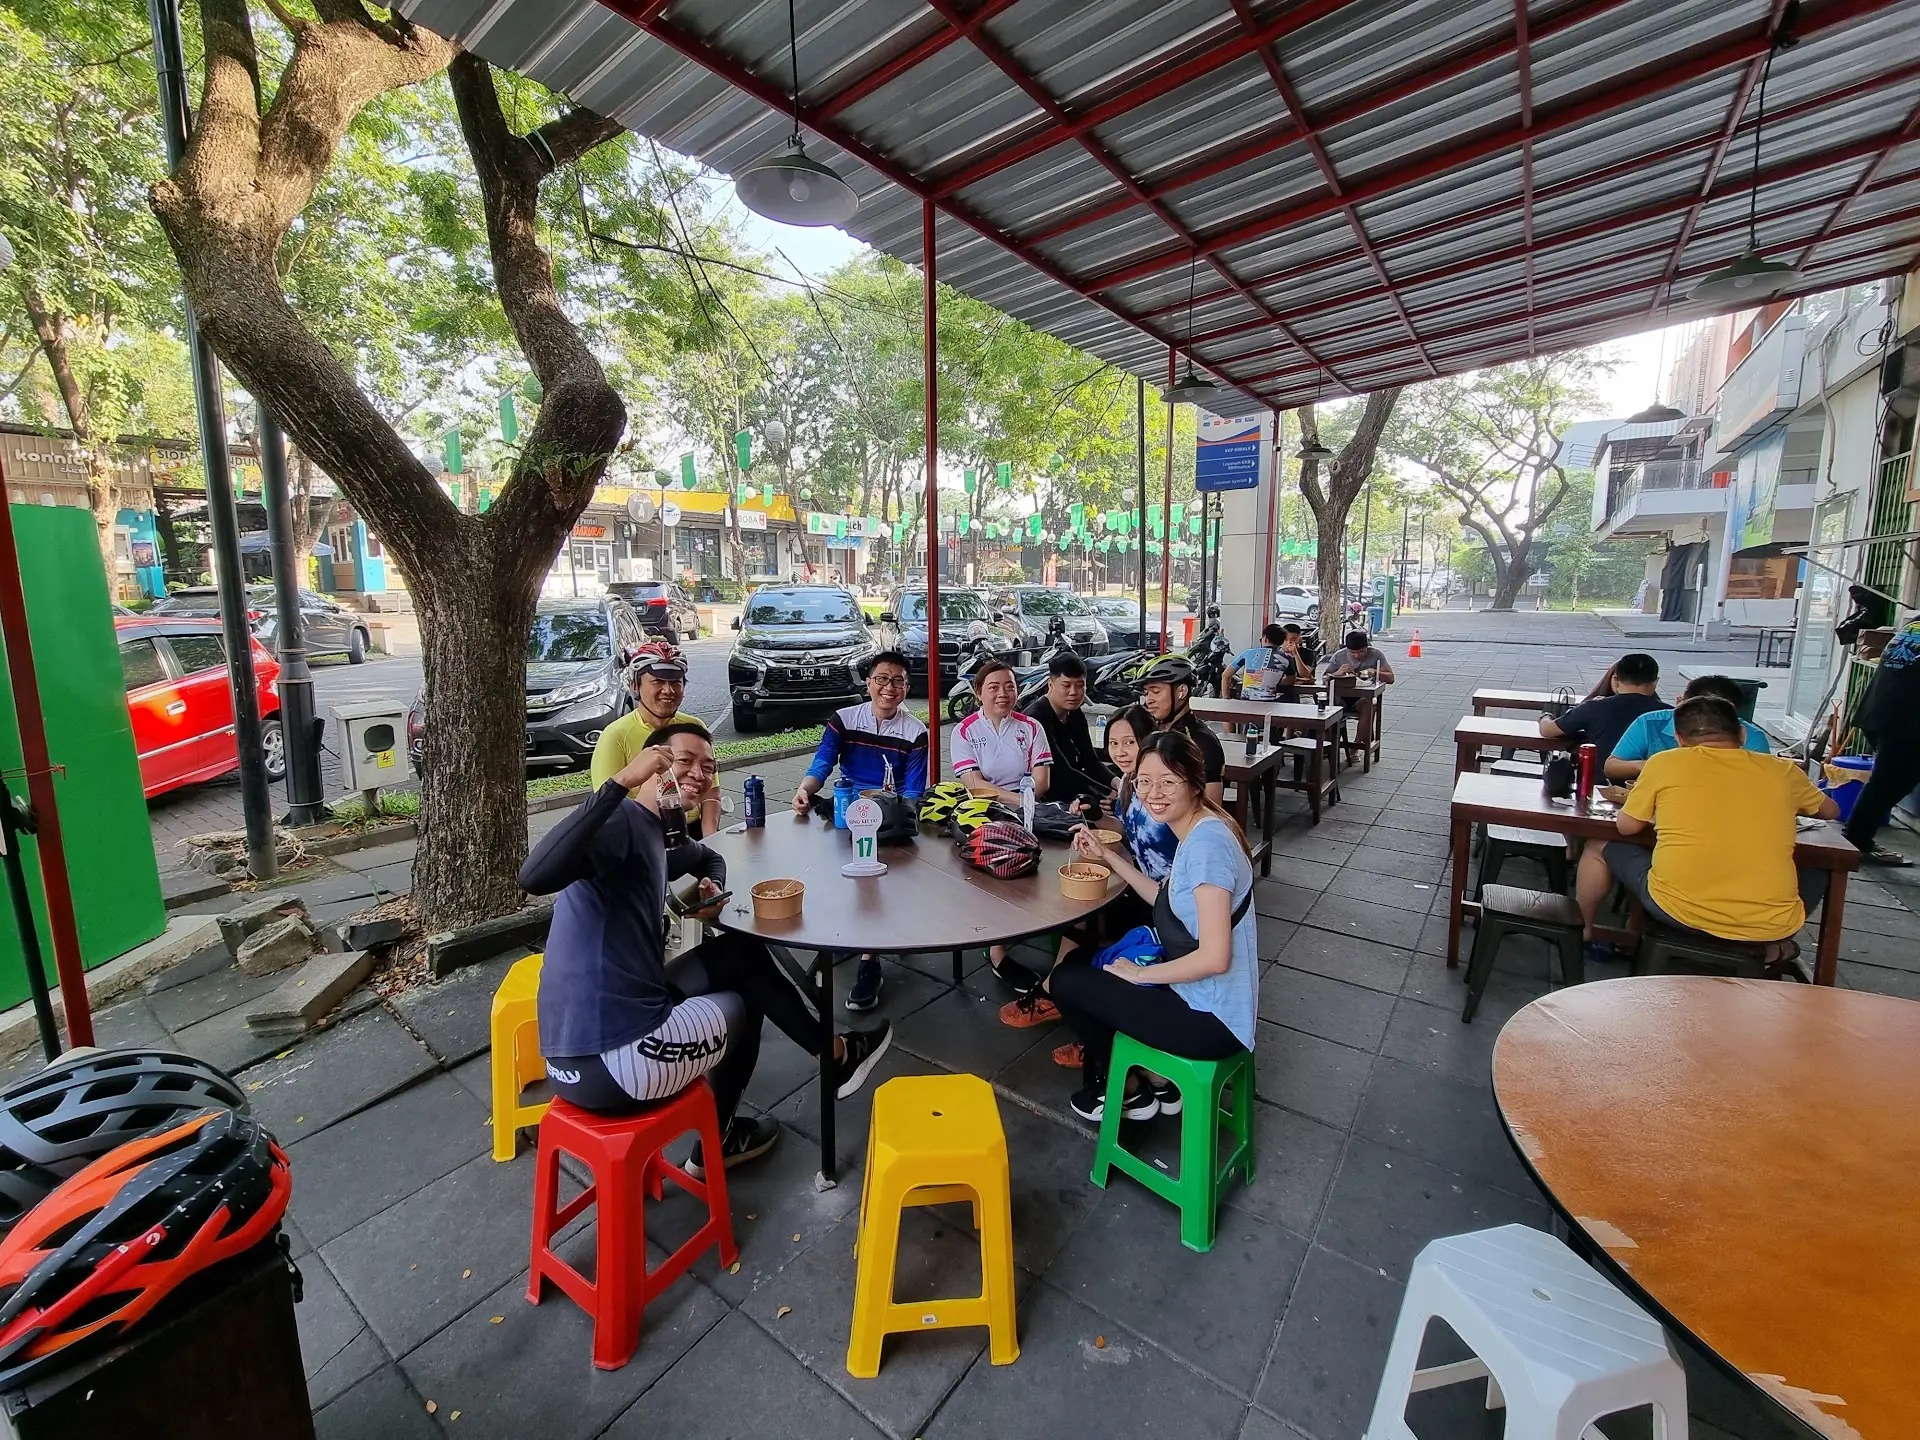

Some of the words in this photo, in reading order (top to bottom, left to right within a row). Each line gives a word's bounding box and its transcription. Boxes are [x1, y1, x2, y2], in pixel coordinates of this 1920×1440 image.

[572, 525, 606, 537] DARURAT
[800, 668, 815, 677] 1343
[856, 837, 873, 858] 17
